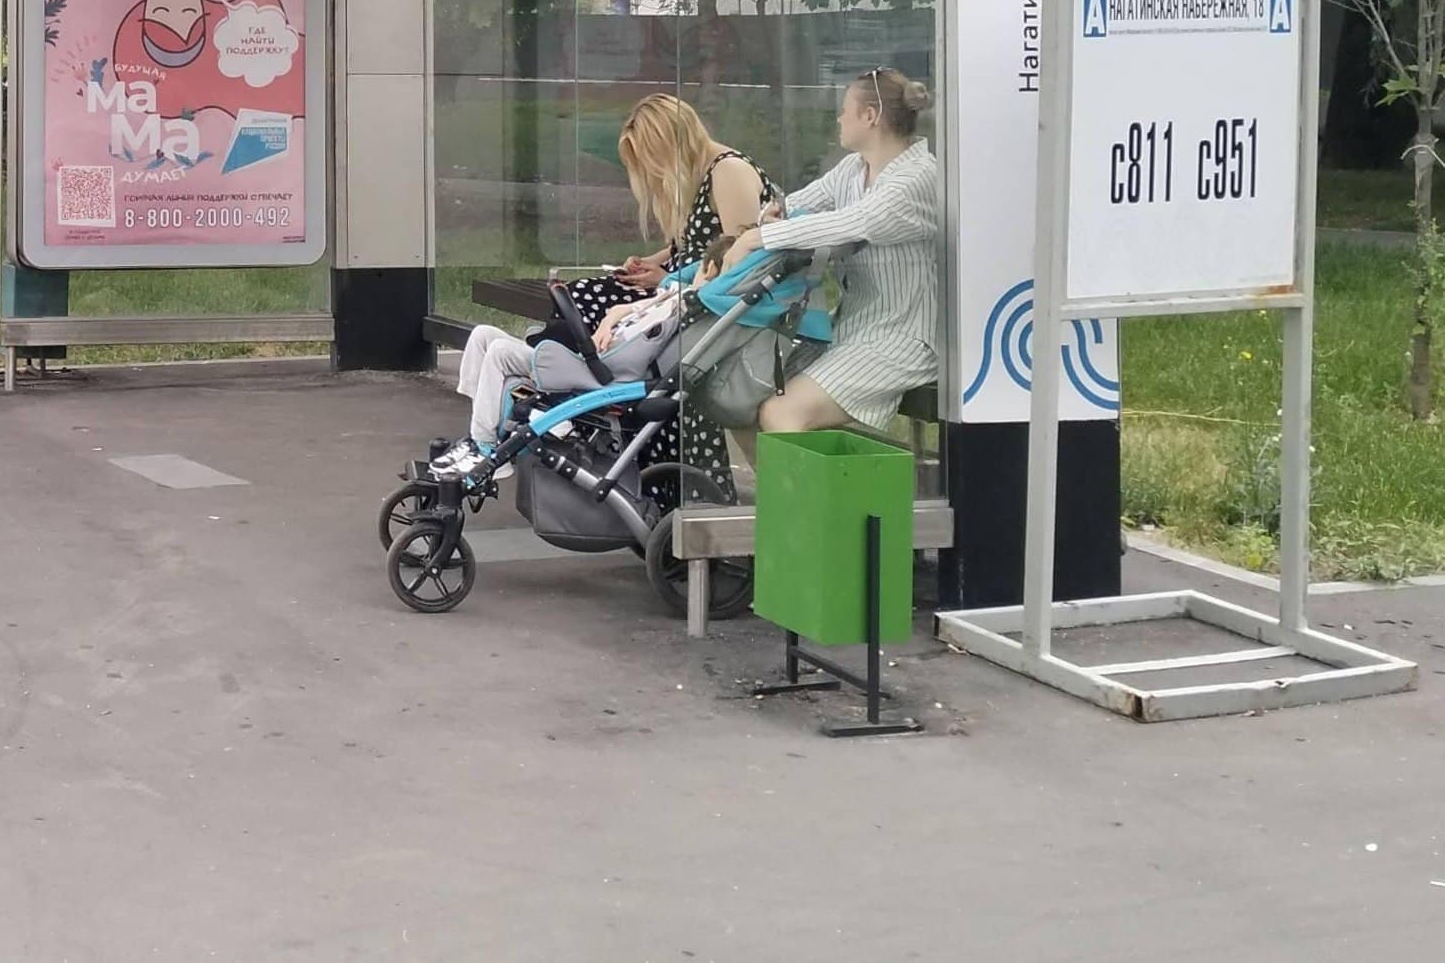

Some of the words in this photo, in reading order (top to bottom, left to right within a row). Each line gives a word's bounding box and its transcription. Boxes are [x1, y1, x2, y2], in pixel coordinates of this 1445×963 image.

[248, 26, 266, 35] ГДЕ
[241, 37, 275, 45] НАЙТИ
[114, 63, 167, 81] БУДУЩАЯ
[120, 166, 187, 184] ДУМАЕТ
[197, 193, 249, 202] ПОДДЕРЖКИ
[124, 206, 291, 228] 8-800-2000-492
